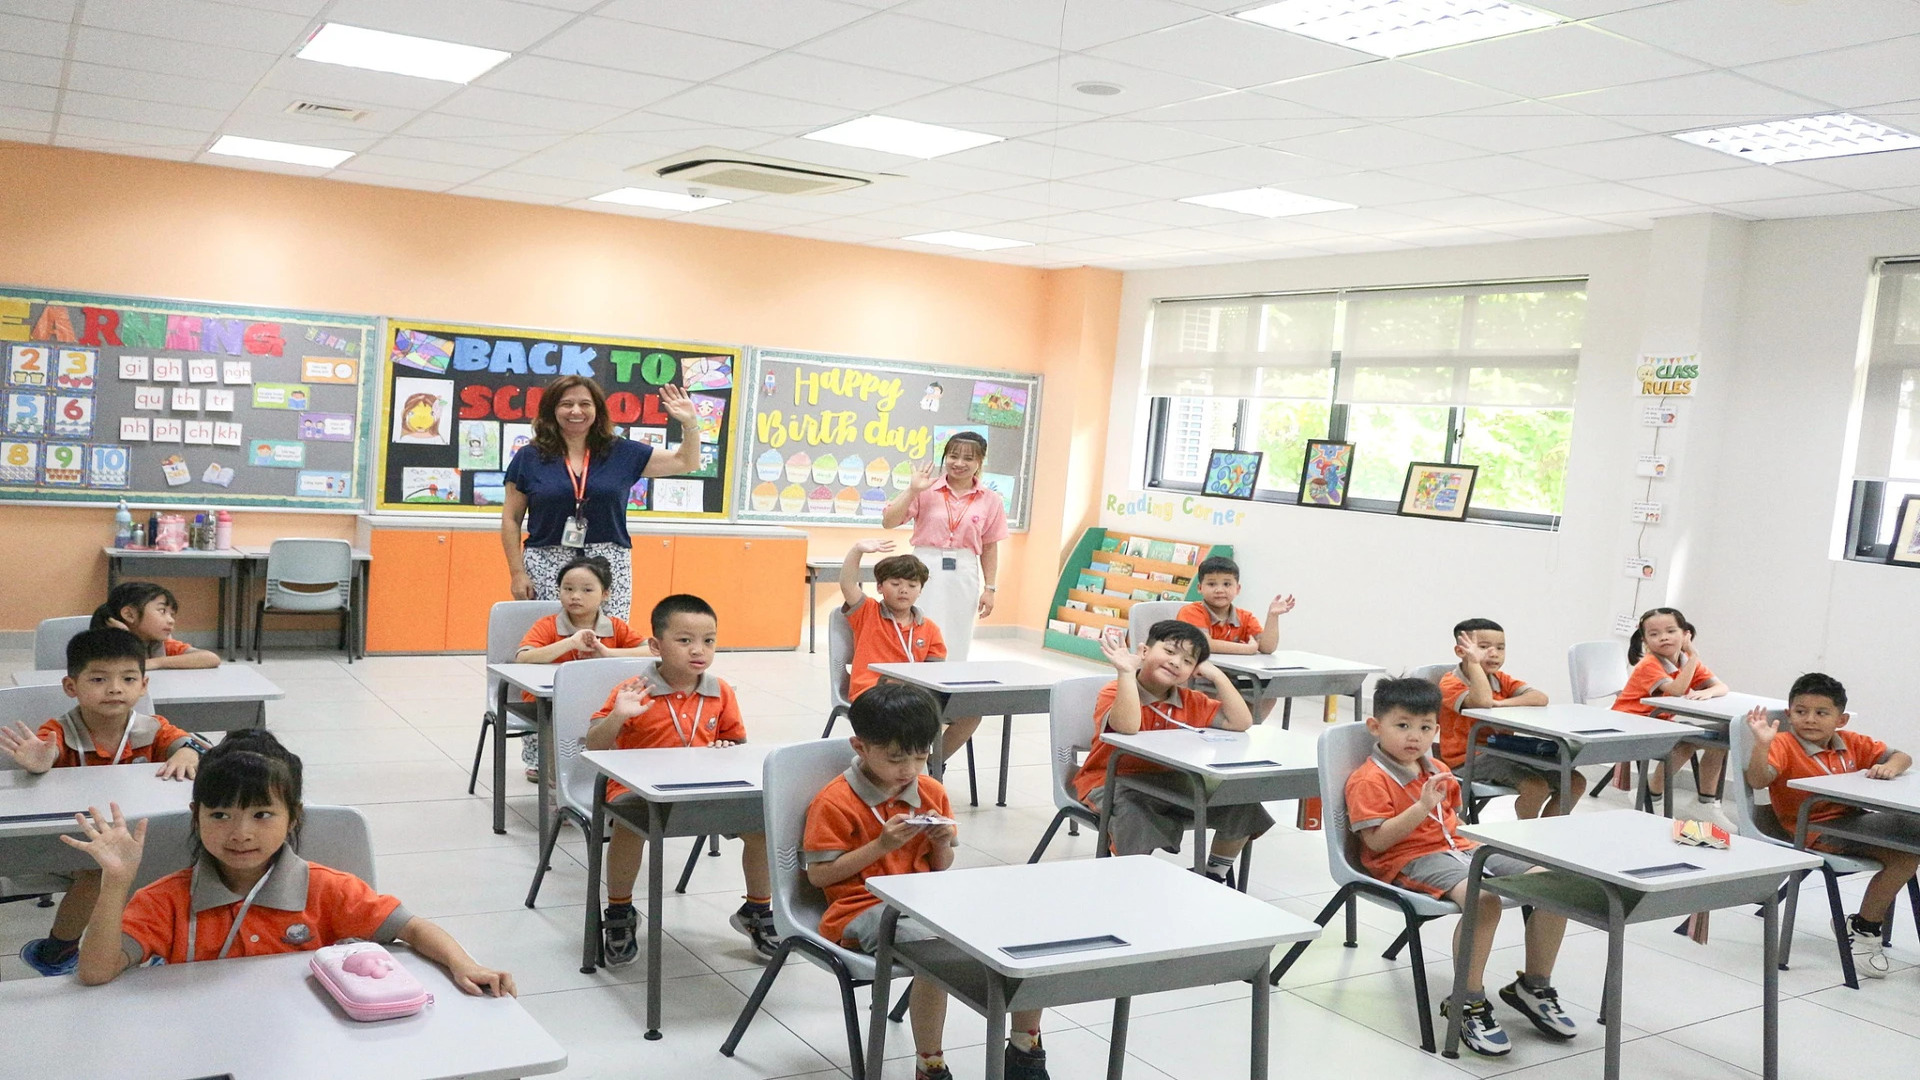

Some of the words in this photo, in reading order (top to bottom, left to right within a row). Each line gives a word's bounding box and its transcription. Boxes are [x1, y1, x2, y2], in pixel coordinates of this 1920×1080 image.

[20, 348, 40, 371] 2
[66, 352, 87, 374] 3
[125, 359, 142, 377] gi
[156, 361, 179, 378] gh
[192, 365, 214, 378] ng
[225, 365, 250, 379] ngh
[453, 336, 597, 378] BACK
[610, 350, 677, 386] TO
[1656, 364, 1699, 379] CLASS
[138, 394, 161, 407] qu
[177, 391, 194, 405] th
[213, 394, 228, 406] tr
[794, 366, 904, 412] Happy
[1642, 380, 1691, 395] RULES
[16, 395, 37, 418] 5
[64, 398, 83, 420] 6
[458, 384, 668, 425] SCOL
[123, 420, 146, 433] nh
[156, 422, 179, 438] ph
[189, 425, 208, 438] ch
[217, 425, 238, 439] kh
[7, 444, 29, 466] 8
[55, 446, 73, 468] 9
[94, 449, 124, 471] 10
[1106, 493, 1174, 521] Reading
[1182, 496, 1246, 526] Corner
